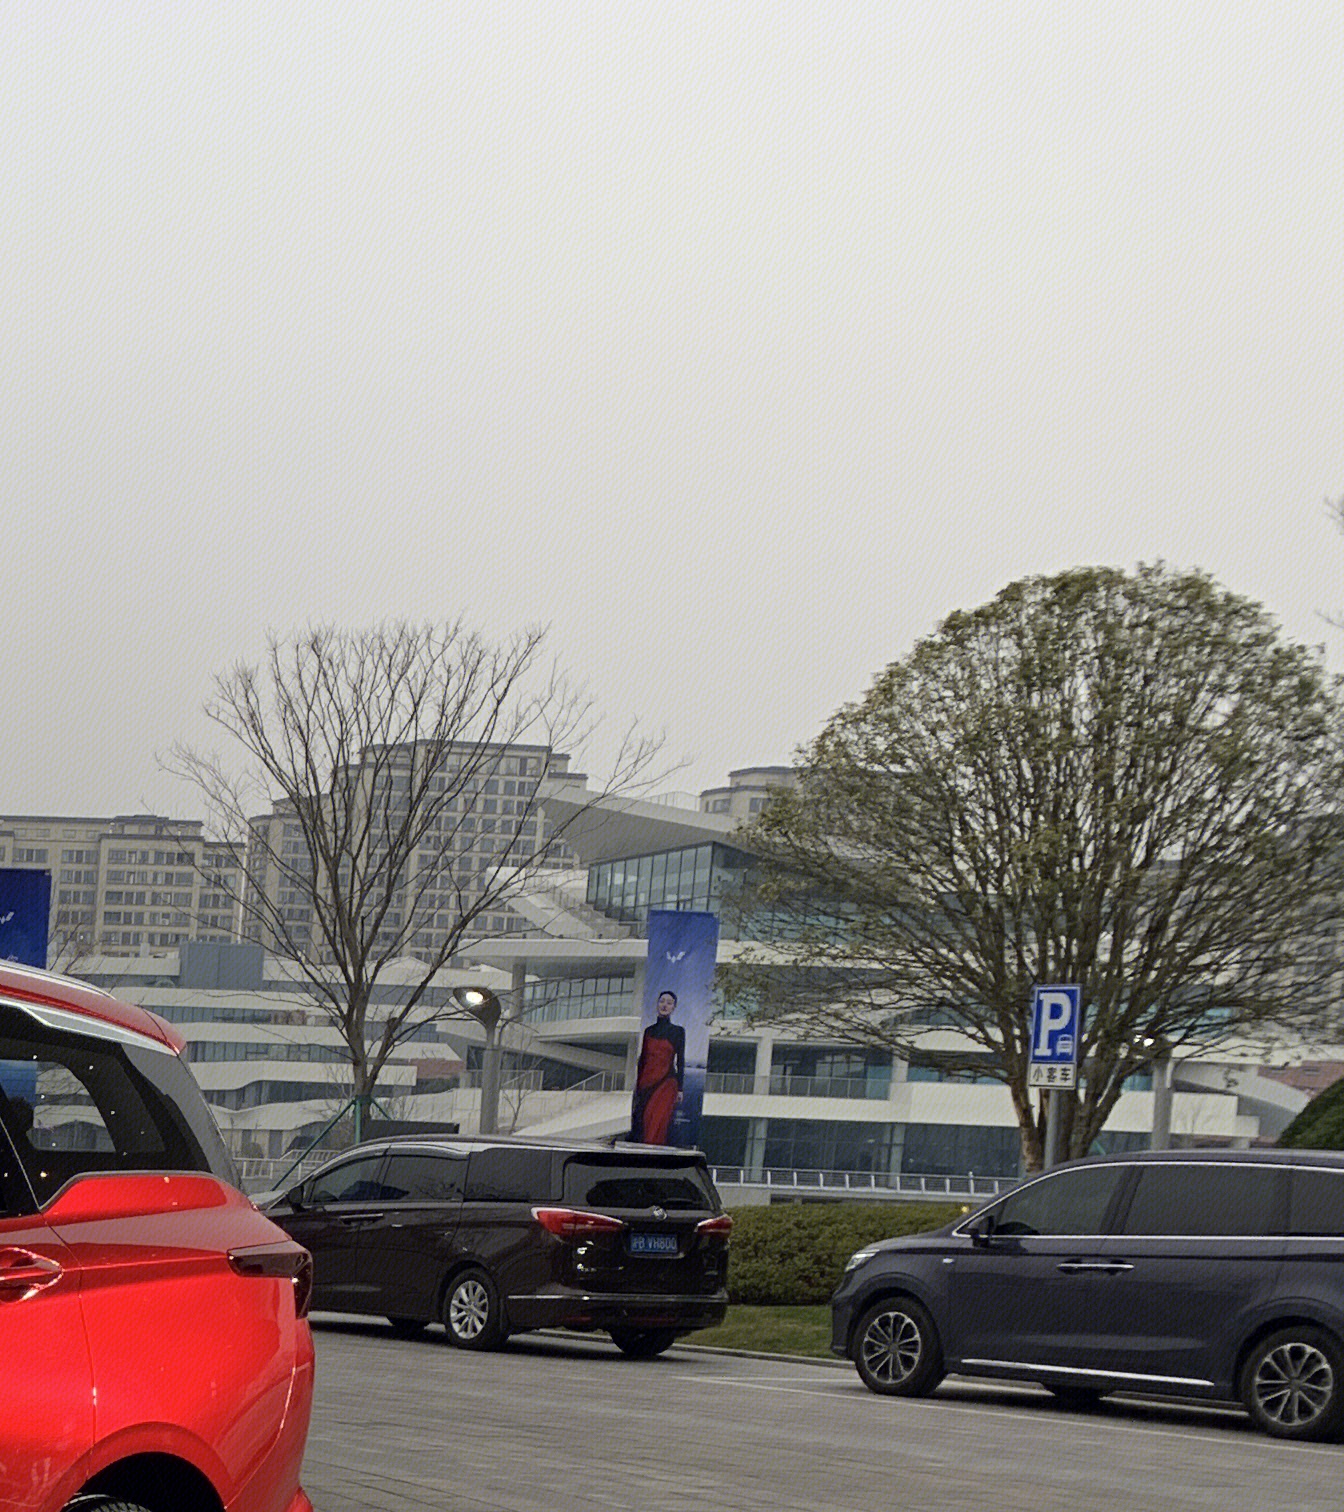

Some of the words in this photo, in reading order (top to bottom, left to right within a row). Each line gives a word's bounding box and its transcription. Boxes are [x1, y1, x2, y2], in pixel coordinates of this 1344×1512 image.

[1034, 992, 1072, 1056] P
[1032, 1065, 1072, 1083] 小客车
